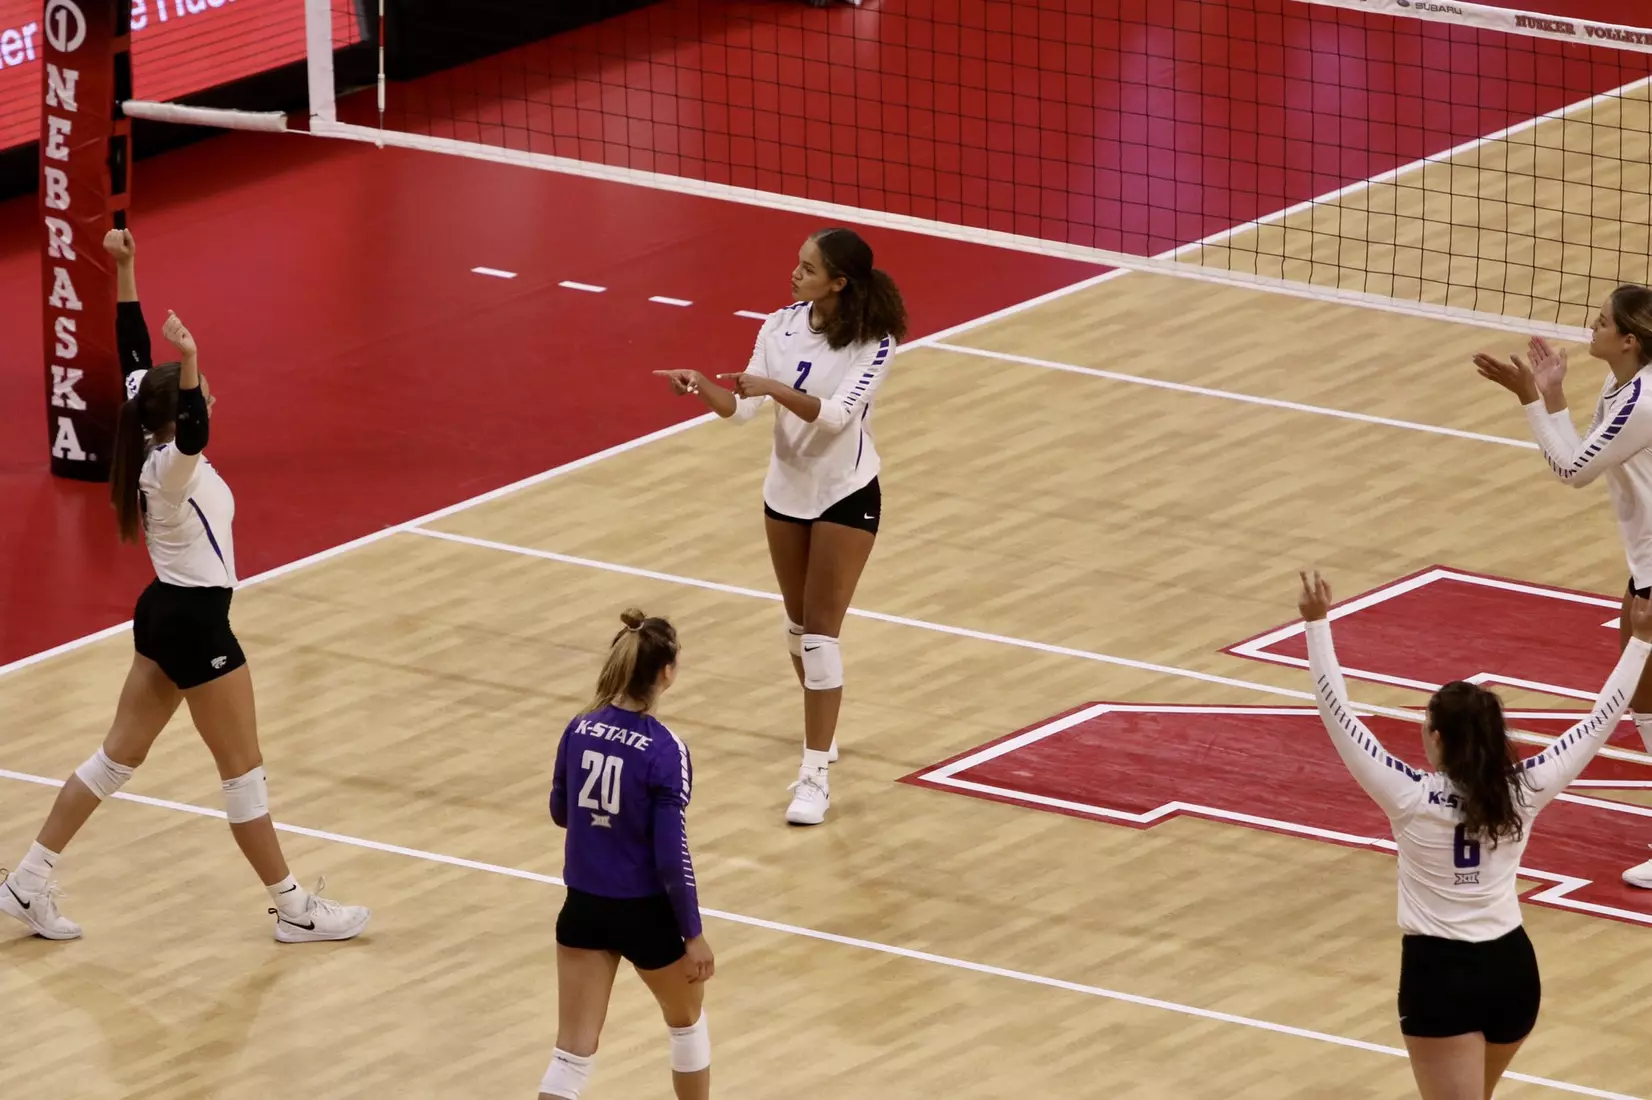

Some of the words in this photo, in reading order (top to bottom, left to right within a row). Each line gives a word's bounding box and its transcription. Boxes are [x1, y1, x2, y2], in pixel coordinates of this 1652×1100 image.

[1414, 2, 1463, 15] SUBARU
[1514, 14, 1577, 36] HUSKER
[0, 22, 38, 70] er
[45, 63, 87, 461] NEBRASKA
[793, 360, 812, 394] 2
[574, 719, 653, 751] K-STATE
[577, 749, 624, 815] 20
[1453, 822, 1480, 868] 6
